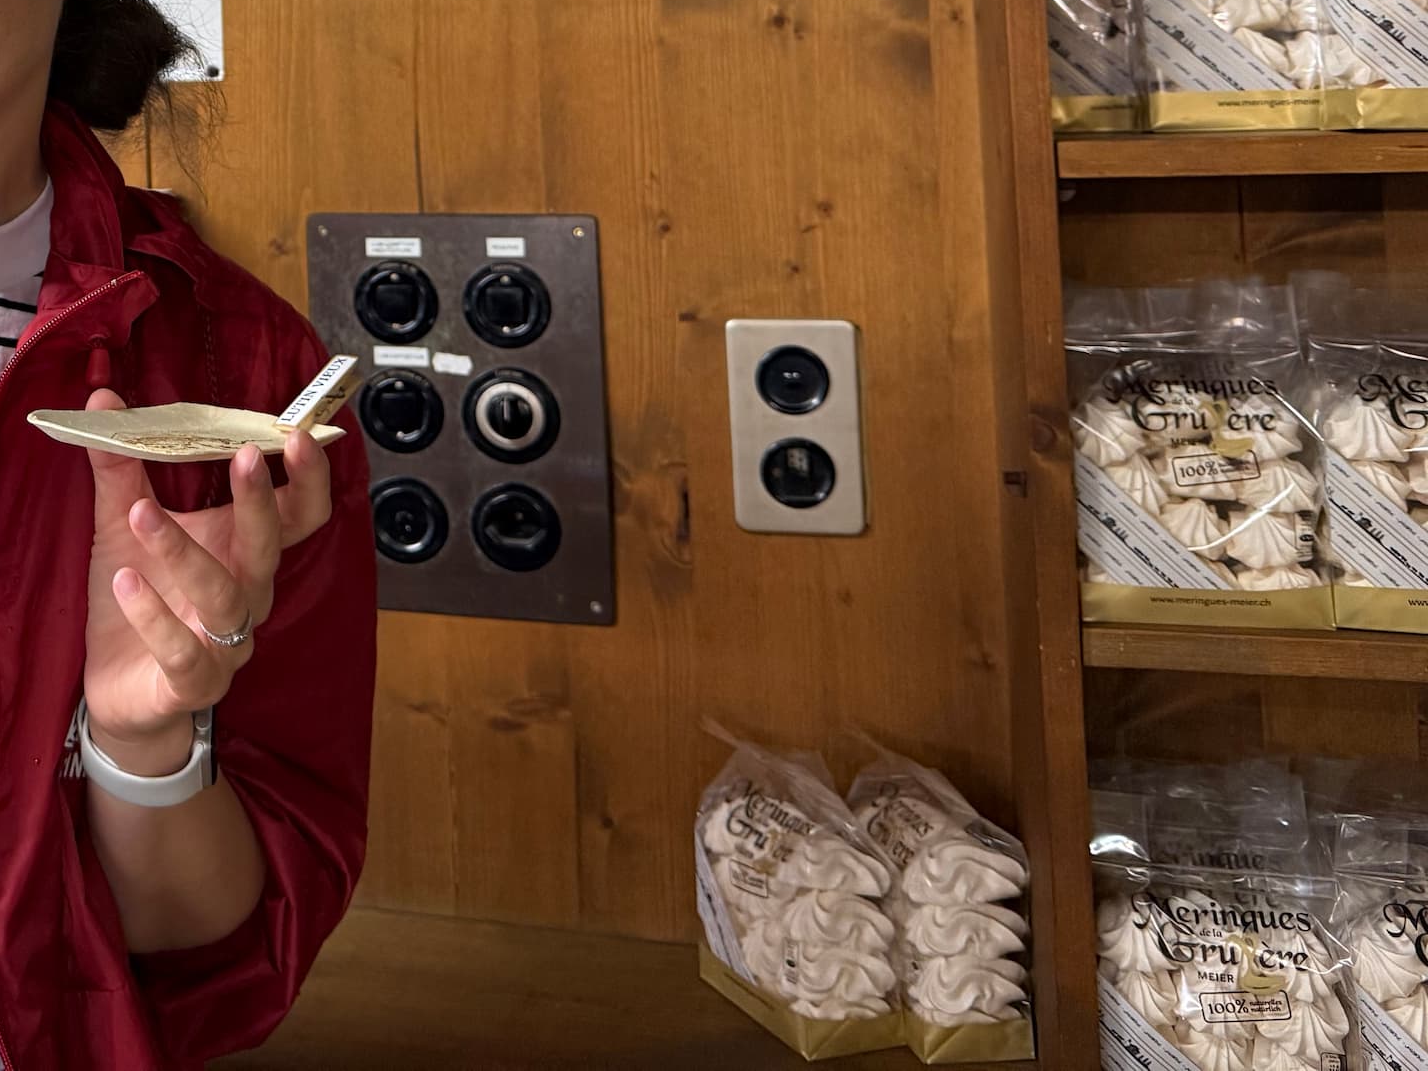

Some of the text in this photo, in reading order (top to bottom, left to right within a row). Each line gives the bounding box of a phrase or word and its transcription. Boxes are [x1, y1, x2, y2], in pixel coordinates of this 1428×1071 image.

[280, 389, 318, 422] LUTIN
[312, 357, 347, 387] VIEUX
[1179, 459, 1220, 478] 100%
[1149, 595, 1272, 608] www.meringues-meier.ch
[1131, 892, 1312, 934] Meringues
[1199, 928, 1223, 938] de la
[1197, 970, 1234, 983] MEIER
[1208, 999, 1250, 1015] 100%
